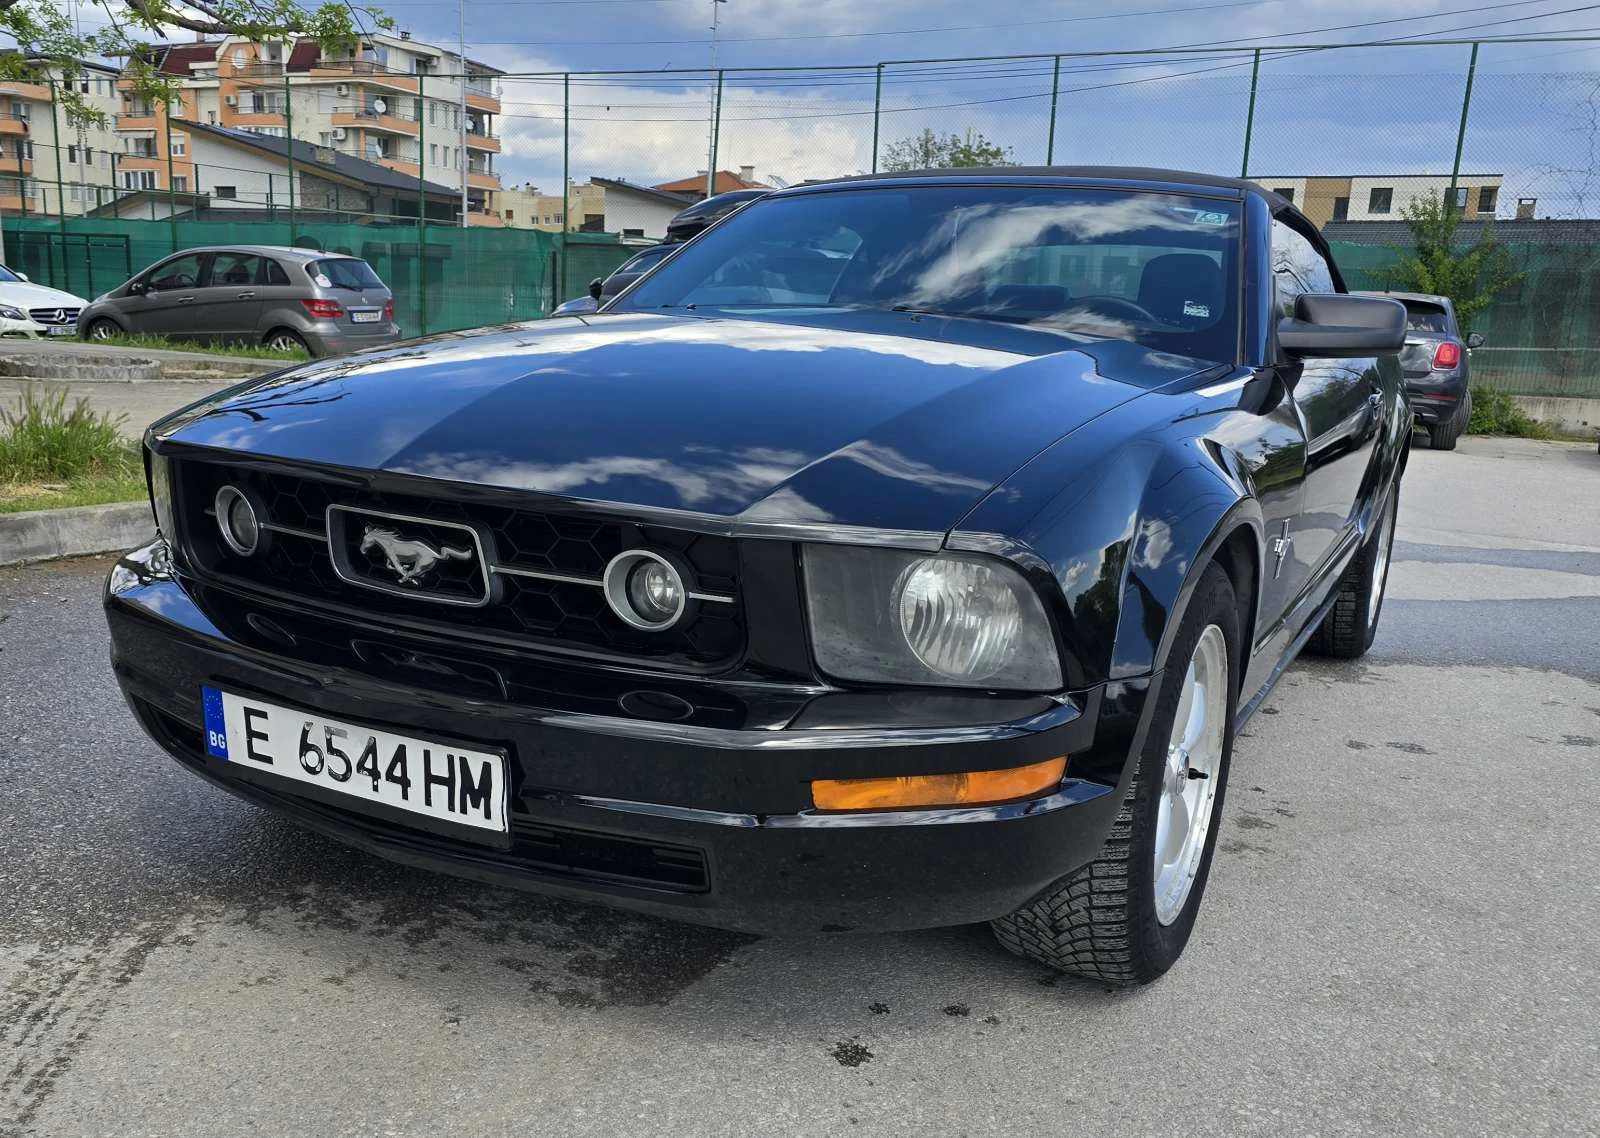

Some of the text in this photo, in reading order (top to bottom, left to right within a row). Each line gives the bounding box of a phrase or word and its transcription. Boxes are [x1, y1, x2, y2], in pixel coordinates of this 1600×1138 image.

[210, 730, 226, 749] BG
[243, 706, 493, 820] E 6544 HM
